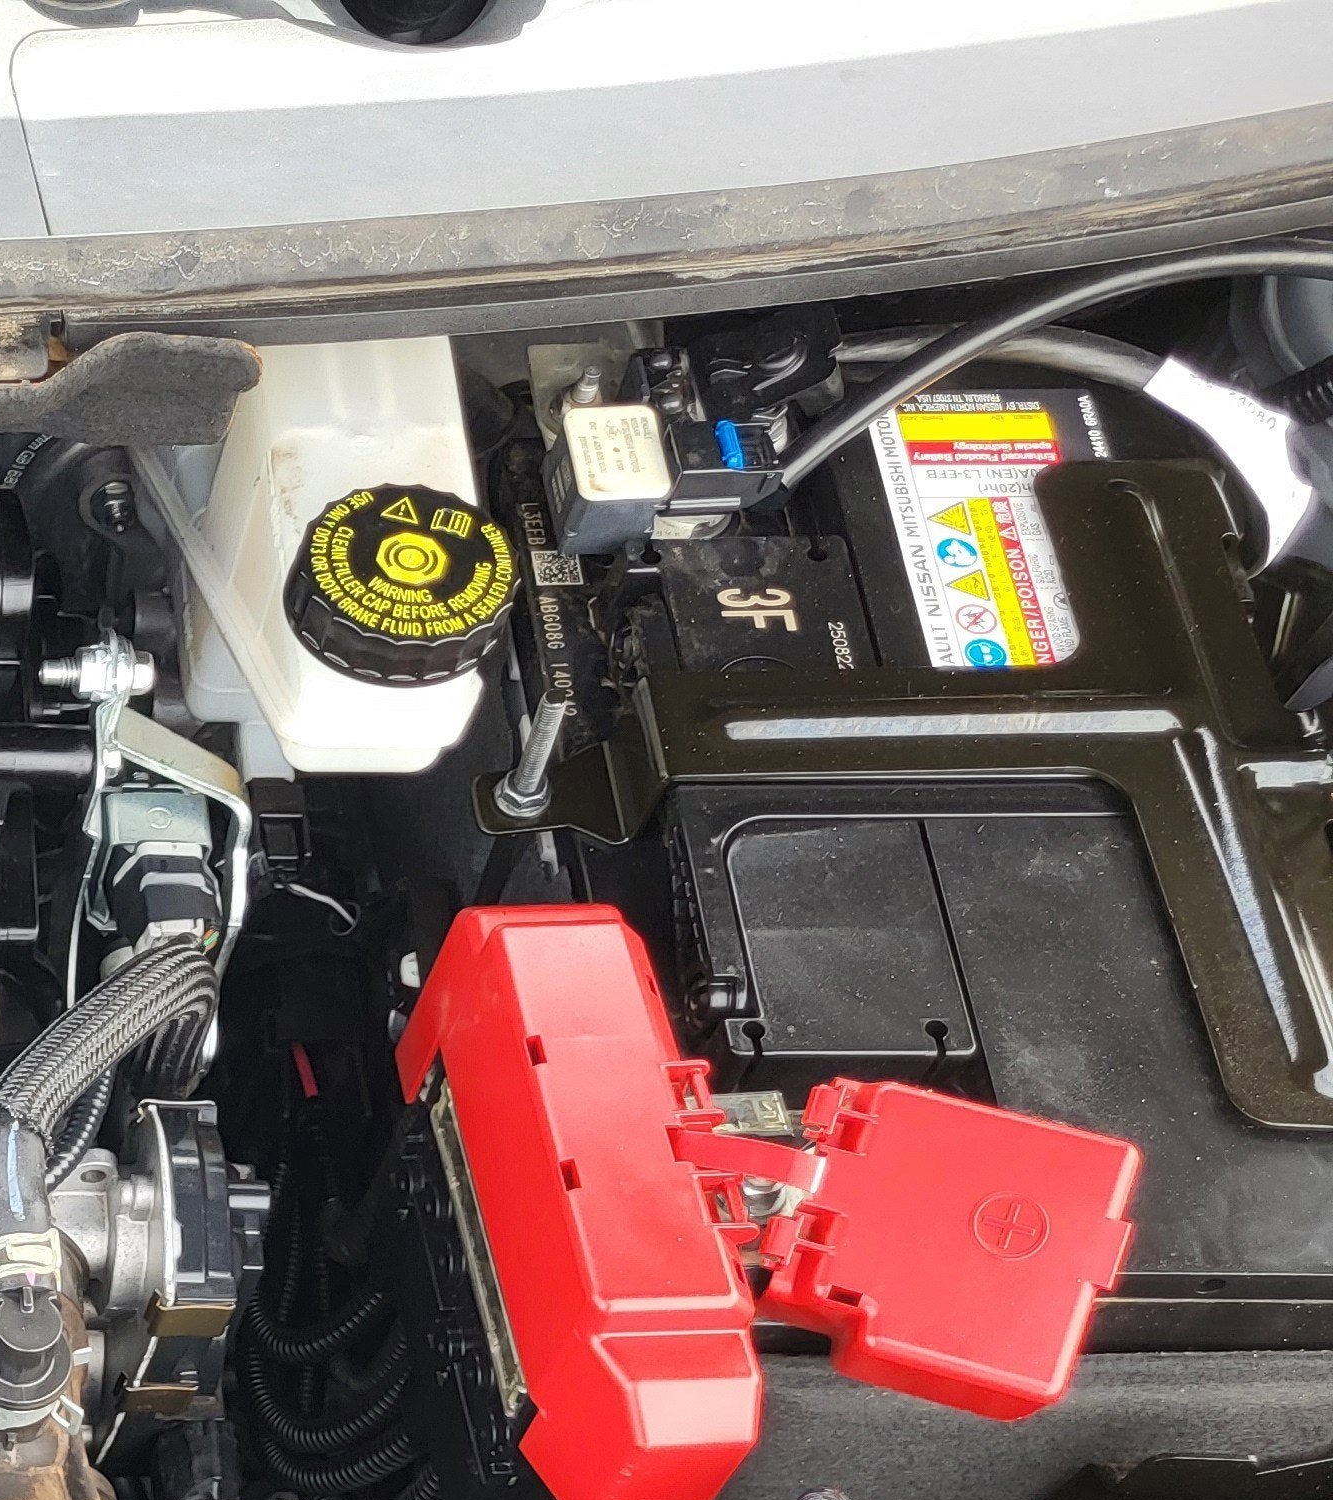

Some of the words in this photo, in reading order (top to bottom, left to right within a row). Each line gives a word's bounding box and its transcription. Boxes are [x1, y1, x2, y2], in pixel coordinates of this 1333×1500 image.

[950, 402, 974, 411] NORTH
[975, 402, 1003, 411] NISSAN
[1006, 402, 1017, 410] BY
[1077, 394, 1098, 427] 6RA0A
[953, 440, 1012, 452] technology
[1014, 440, 1052, 451] special
[1087, 428, 1108, 459] 24410
[913, 451, 954, 462] Battery
[954, 452, 1000, 462] Flooded
[1001, 452, 1057, 462] Enhanced
[926, 468, 981, 479] L3-EFB
[987, 467, 1039, 480] 0A(EN)
[978, 482, 1032, 494] h(20hr)
[345, 491, 374, 510] USE
[890, 460, 921, 539] MITSUBISHI
[321, 503, 350, 528] ONLY
[310, 526, 331, 554] DOT3
[331, 526, 354, 560] CLEAN
[481, 522, 512, 582] CONTAINER
[311, 556, 329, 573] OR
[315, 572, 344, 601] DOT4
[333, 559, 366, 598] FILLER
[447, 561, 493, 612] REMOVING
[909, 544, 943, 618] NISSAN
[367, 575, 433, 603] WARNING
[361, 593, 392, 613] CAP
[472, 581, 508, 619] SEALED
[716, 588, 798, 632] 3F
[1005, 547, 1054, 665] NGER/POISON
[337, 597, 380, 628] BRAKE
[392, 602, 450, 619] BEFORE
[463, 612, 477, 626] A
[380, 617, 422, 636] FLUID
[425, 617, 465, 637] FROM
[933, 626, 954, 665] AULT
